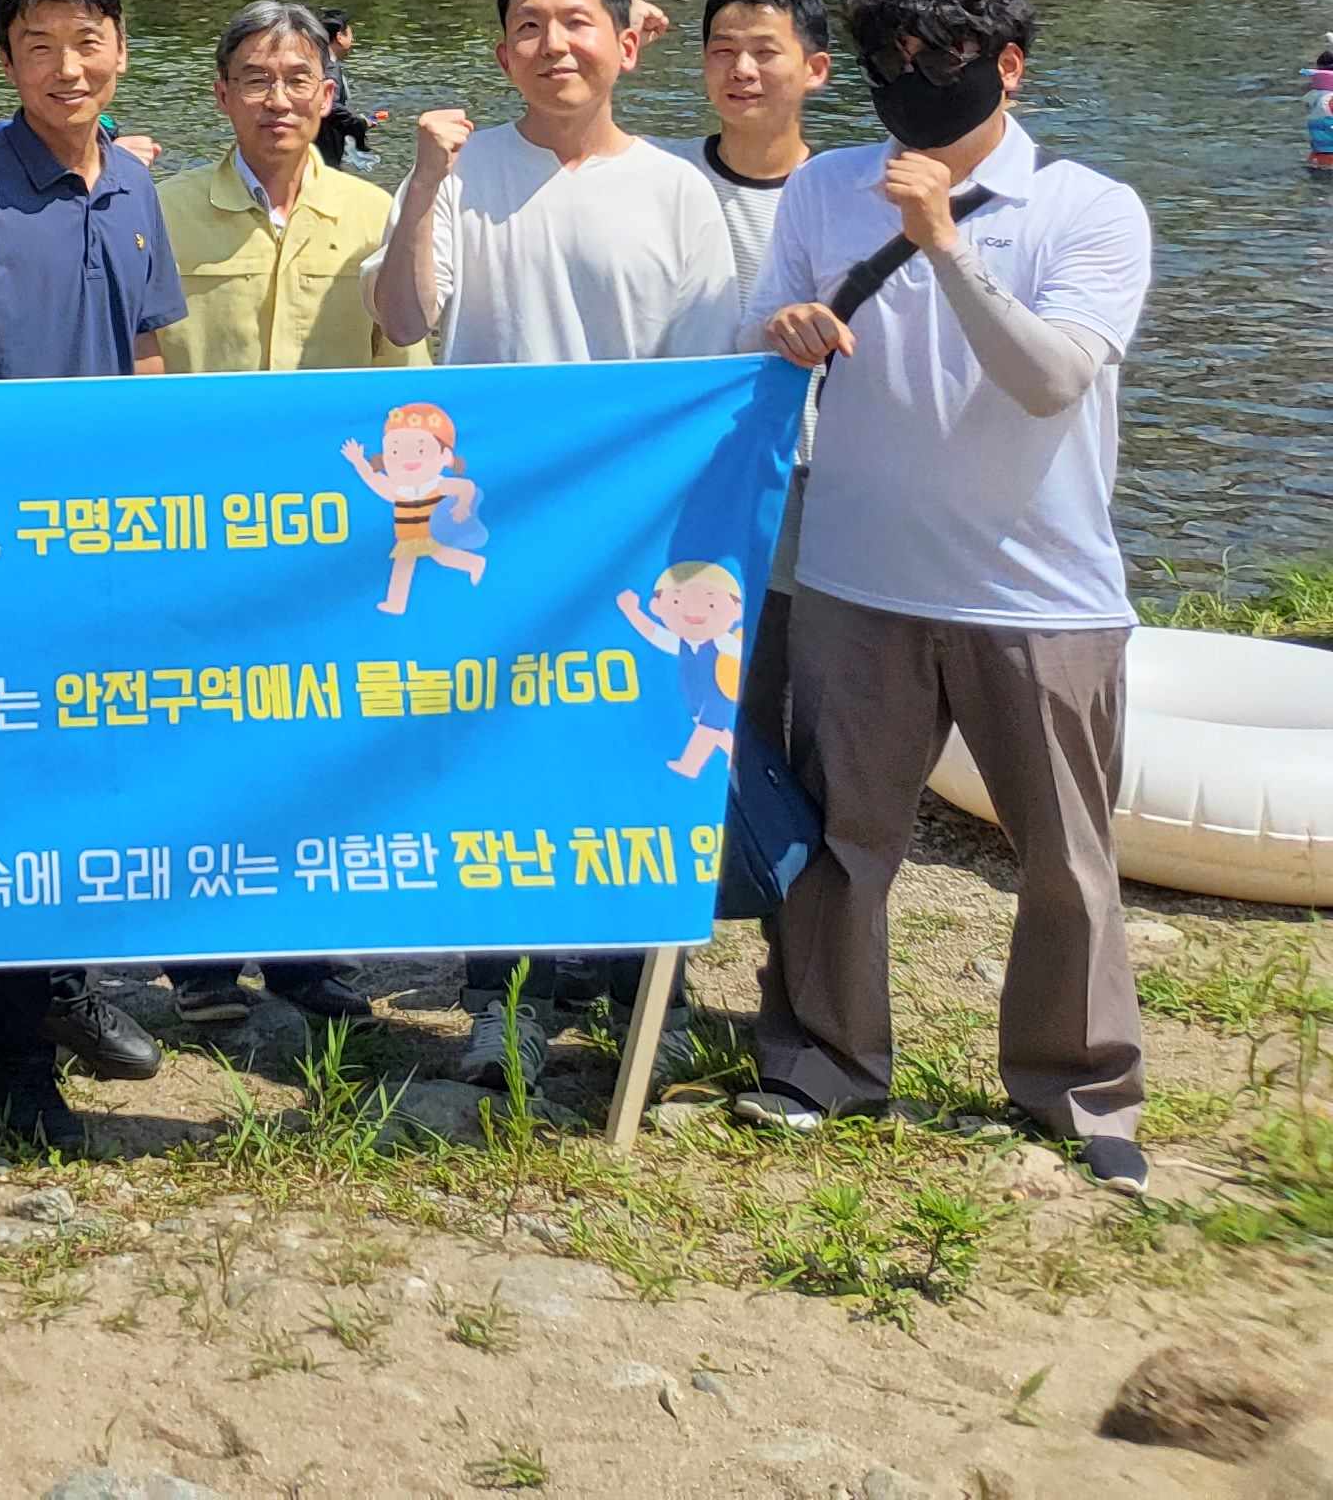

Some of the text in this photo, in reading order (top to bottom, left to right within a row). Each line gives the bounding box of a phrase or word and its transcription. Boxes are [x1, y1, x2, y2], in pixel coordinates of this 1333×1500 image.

[16, 495, 207, 556] 구명조끼
[222, 492, 349, 549] 입GO
[55, 662, 342, 729] 안전구역에서
[355, 655, 497, 717] 물놀이
[510, 649, 640, 707] 하GO
[77, 845, 170, 902] 오래
[187, 840, 279, 898] 있는
[294, 831, 438, 893] 위험한
[450, 826, 555, 889] 장난
[569, 824, 677, 886] 치지
